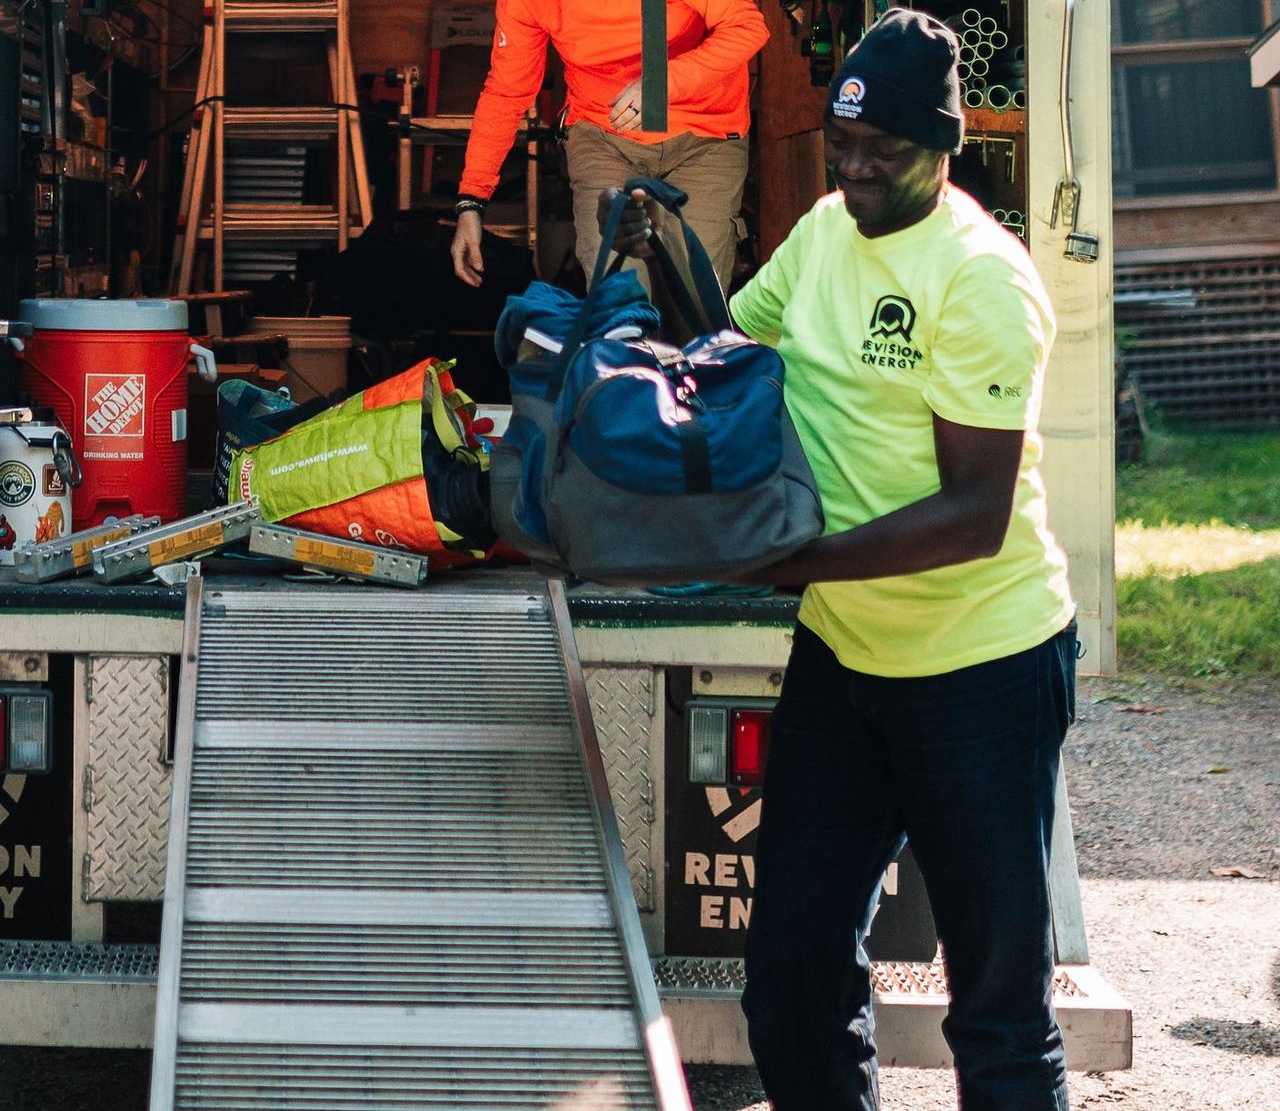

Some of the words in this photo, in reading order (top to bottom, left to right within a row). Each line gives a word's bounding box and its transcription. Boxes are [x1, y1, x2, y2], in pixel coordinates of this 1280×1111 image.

[862, 353, 915, 369] ENERGY
[87, 376, 143, 433] HOME
[92, 381, 117, 405] THE
[109, 397, 143, 434] DEPOT
[271, 444, 368, 475] www.shaws.com
